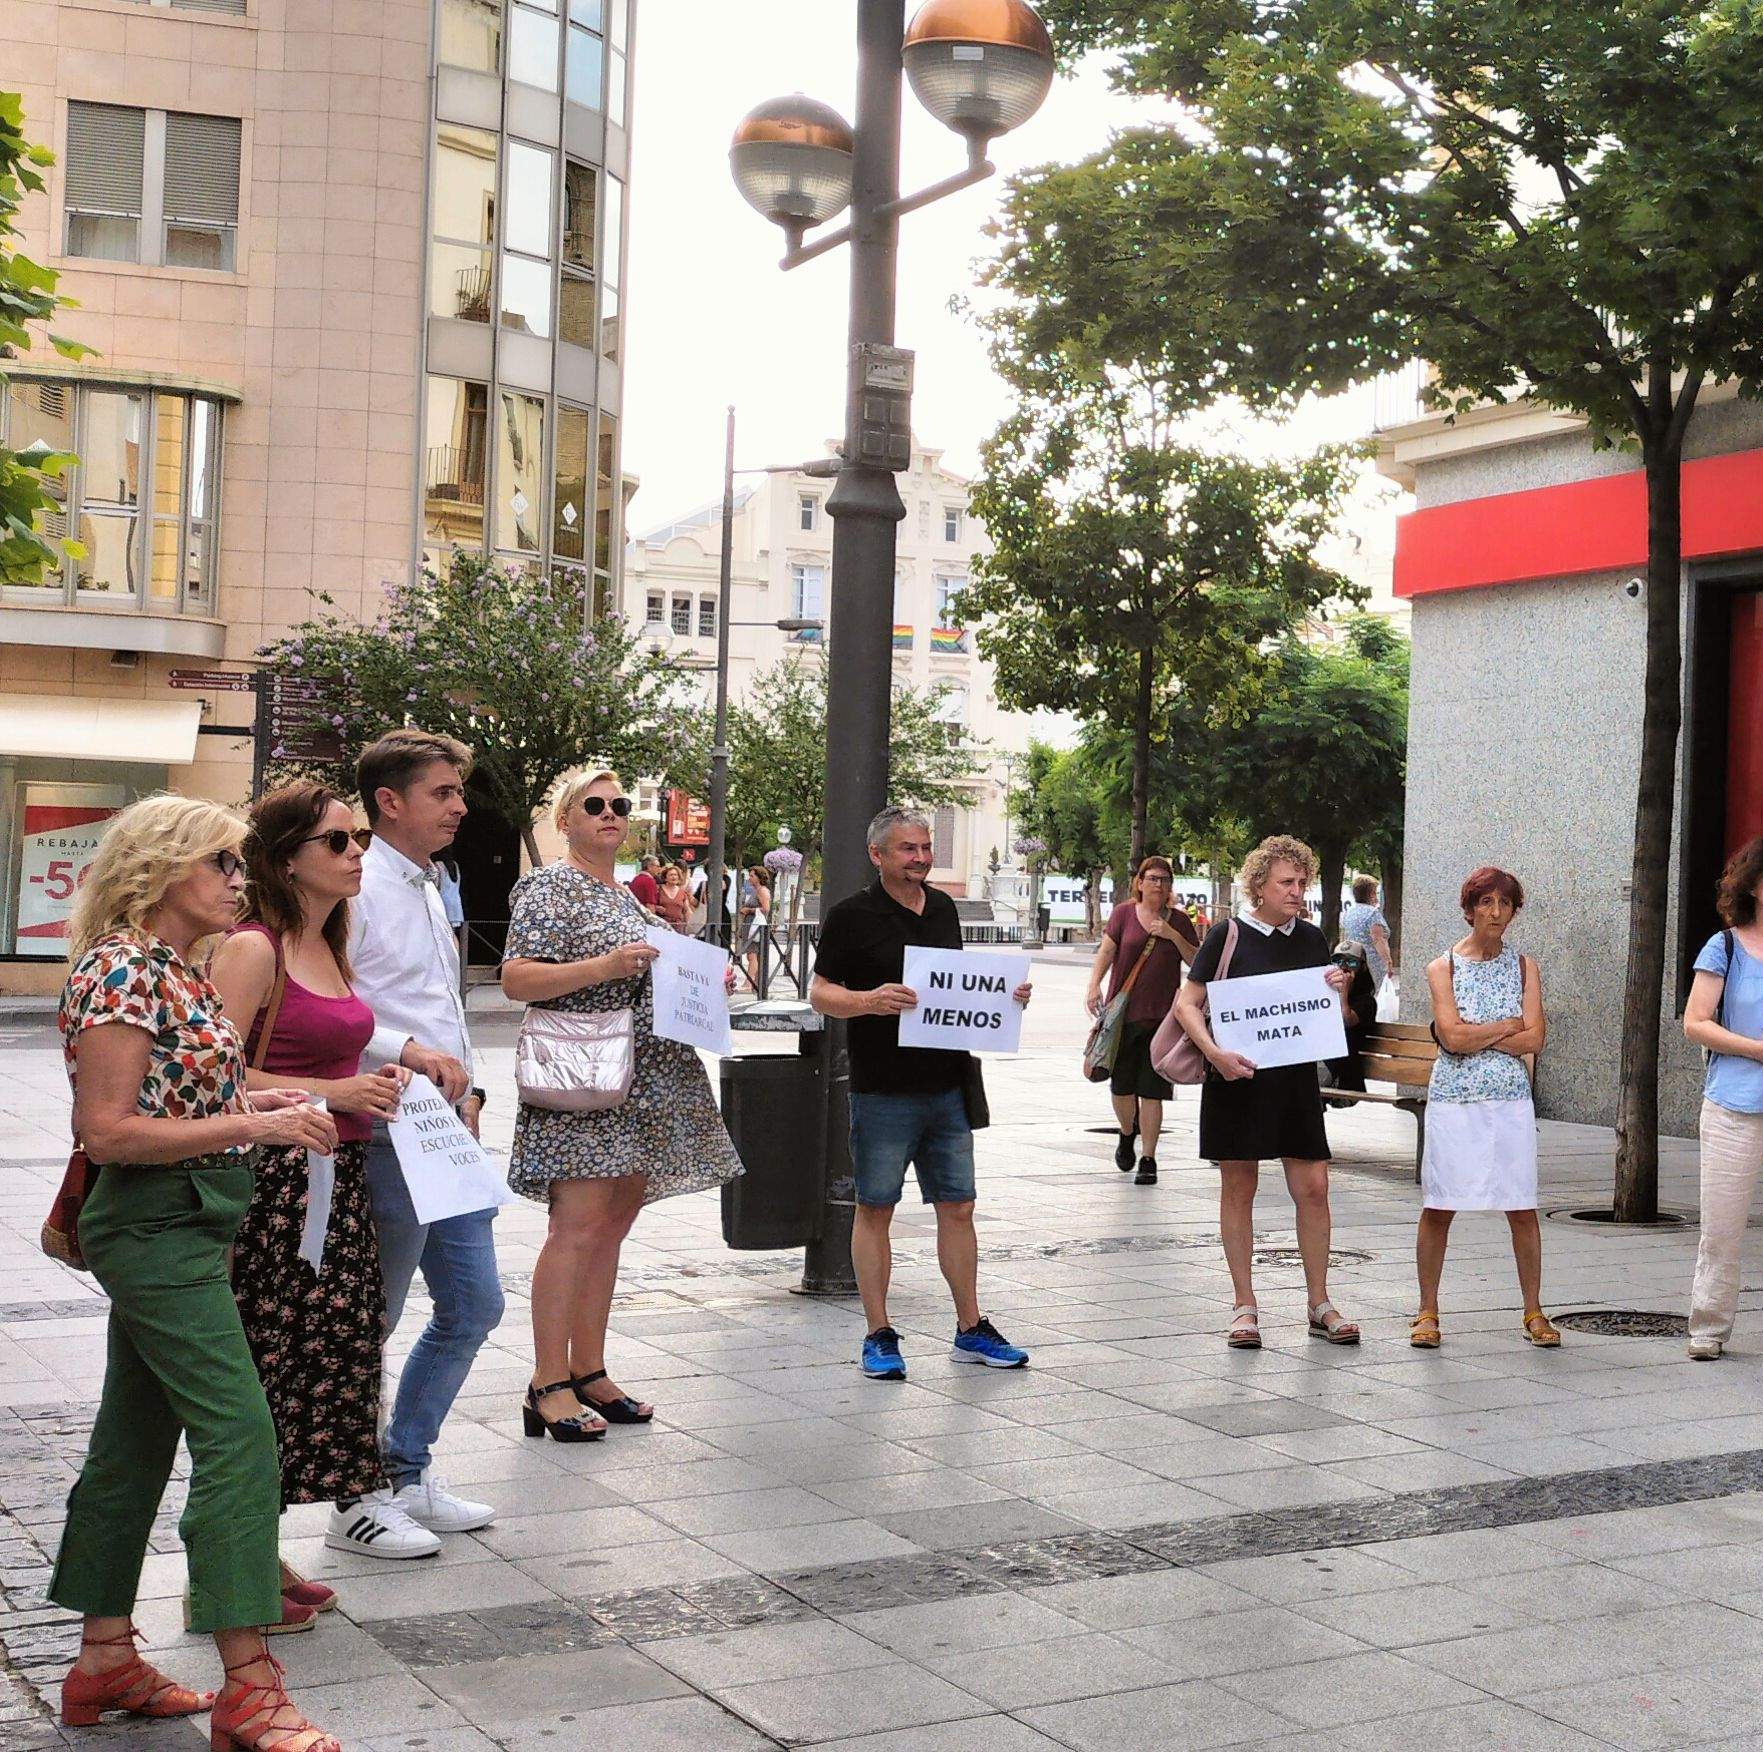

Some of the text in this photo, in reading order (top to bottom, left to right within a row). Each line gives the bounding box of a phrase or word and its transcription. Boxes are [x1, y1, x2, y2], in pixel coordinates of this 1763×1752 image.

[929, 971, 1007, 994] NI UNA
[922, 1007, 1003, 1030] MENOS
[1220, 997, 1332, 1024] EL MACHISMO
[1257, 1025, 1303, 1042] MATA
